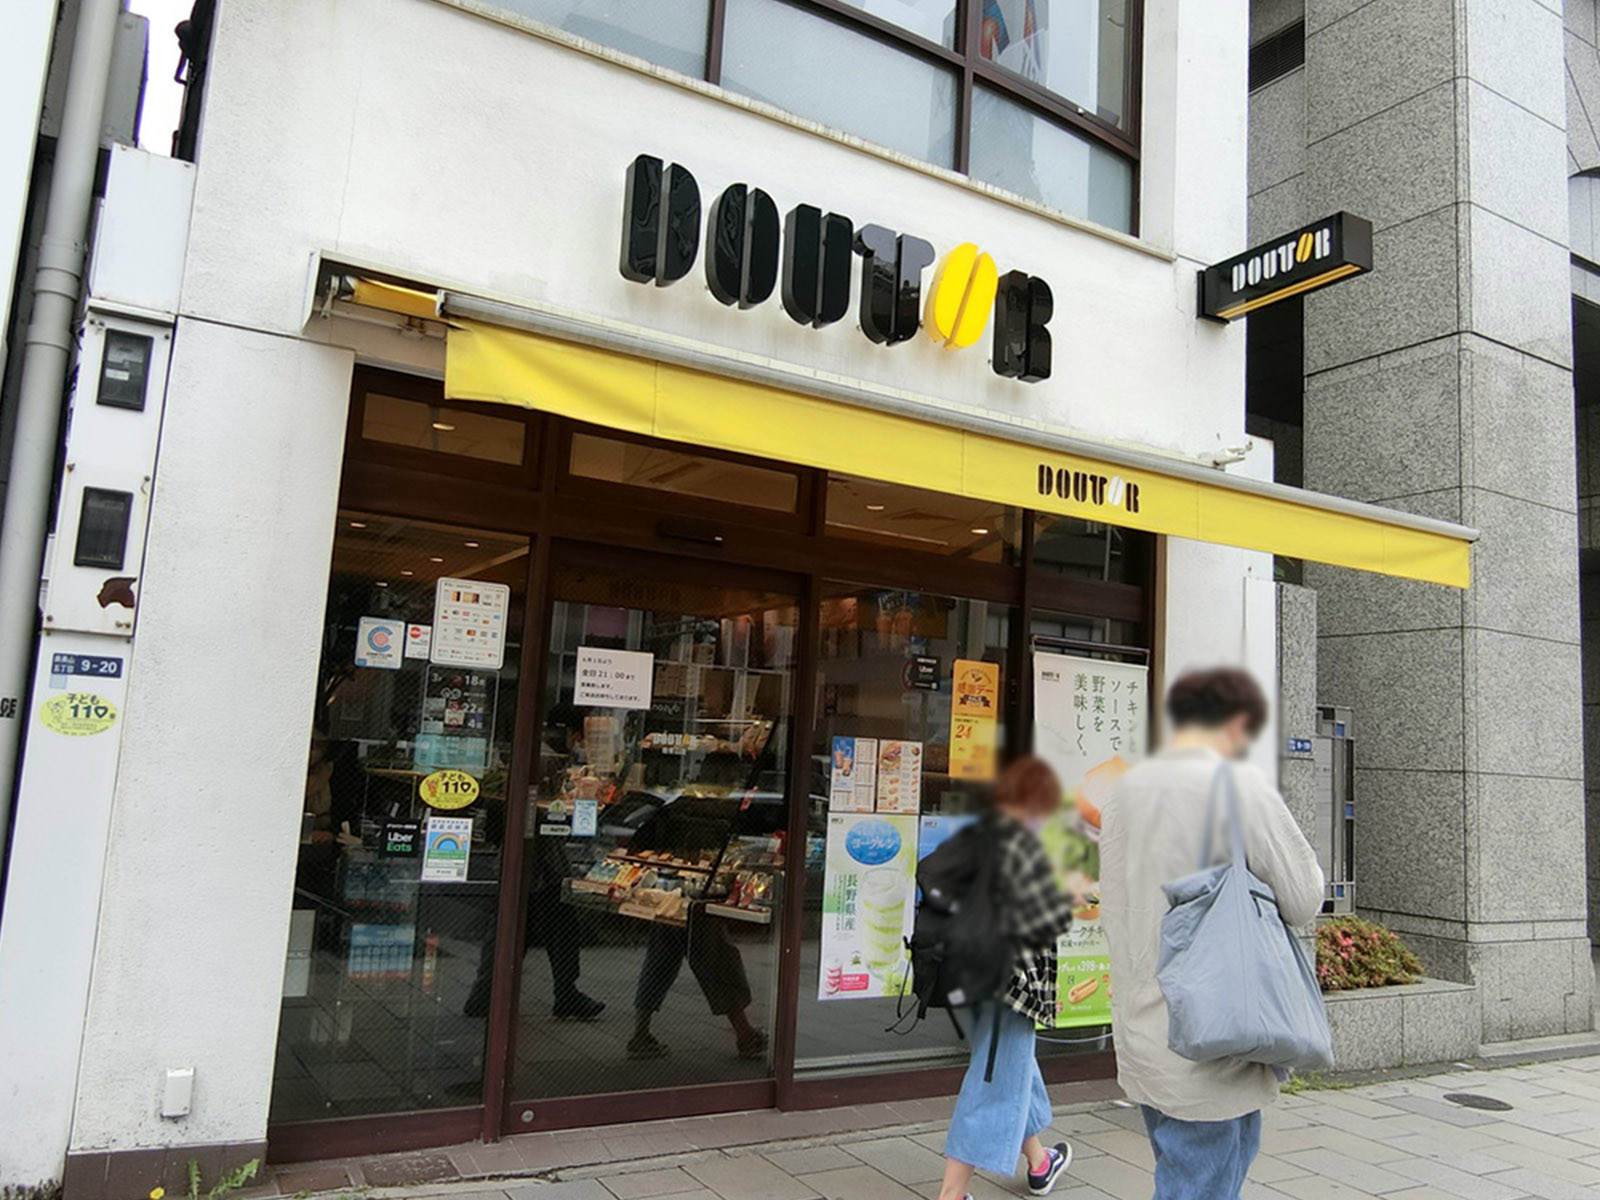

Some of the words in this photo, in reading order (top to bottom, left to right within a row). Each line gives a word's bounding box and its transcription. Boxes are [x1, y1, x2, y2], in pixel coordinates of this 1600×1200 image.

[619, 154, 1054, 383] DOUTOR
[1232, 228, 1330, 292] DOUTOR
[1038, 464, 1139, 513] DOUTOR
[81, 659, 117, 674] 9-20
[67, 693, 100, 705] 子ども
[1092, 675, 1106, 732] 野菜を
[1109, 680, 1121, 751] ソースで
[387, 842, 412, 852] Eats
[388, 832, 414, 842] Uber
[844, 874, 859, 931] 長野県産
